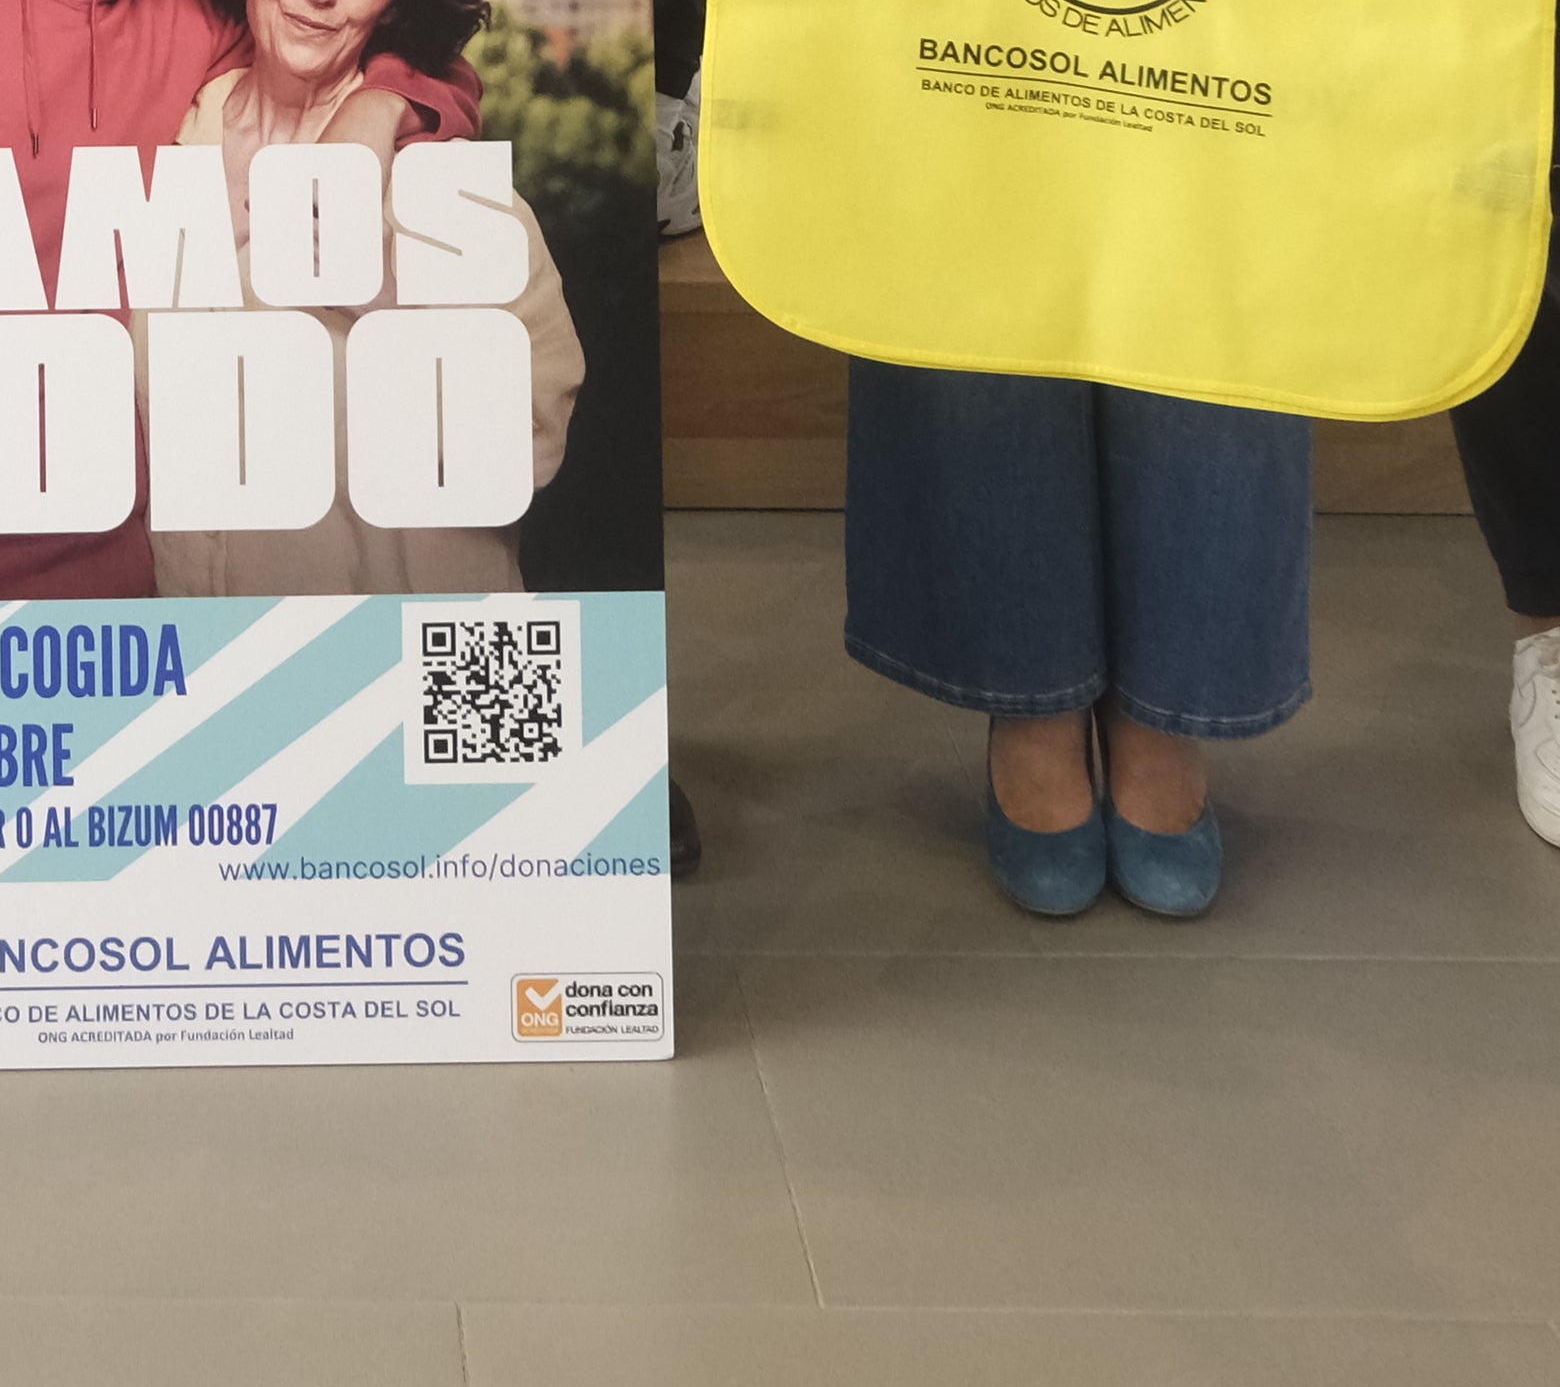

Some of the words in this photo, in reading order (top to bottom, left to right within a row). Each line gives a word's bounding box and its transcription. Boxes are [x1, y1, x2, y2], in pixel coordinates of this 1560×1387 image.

[1061, 6, 1102, 36] DE
[918, 37, 1090, 78] BANCOSOL
[1098, 59, 1273, 106] ALIMENTOS
[921, 78, 976, 96] BANCO
[980, 84, 1000, 98] DE
[1004, 87, 1091, 109] ALIMENTOS
[1096, 99, 1116, 113] DE
[1120, 102, 1140, 117] LA
[1143, 107, 1196, 127] COSTA
[1200, 116, 1230, 132] DEL
[1235, 121, 1267, 138] SOL
[42, 806, 79, 848] AL
[88, 804, 179, 847] BIZUM
[188, 803, 278, 846] 00887
[219, 853, 661, 882] www.bancosol.info/donaciones
[205, 932, 466, 970] ALIMENTOS
[565, 981, 613, 998] dona
[617, 983, 653, 997] con
[28, 1004, 58, 1024] DE
[65, 1003, 198, 1023] ALIMENTOS
[205, 1002, 235, 1021] DE
[243, 1002, 272, 1020] LA
[279, 1000, 357, 1019] COSTA
[364, 1000, 409, 1019] DEL
[416, 999, 461, 1018] SOL
[521, 1012, 559, 1027] ONG
[565, 999, 659, 1018] confianza
[38, 1031, 67, 1044] ONG
[71, 1030, 153, 1044] ACREDITADA
[156, 1032, 177, 1046] por
[180, 1028, 246, 1043] Fundación
[249, 1028, 295, 1042] Lealtad
